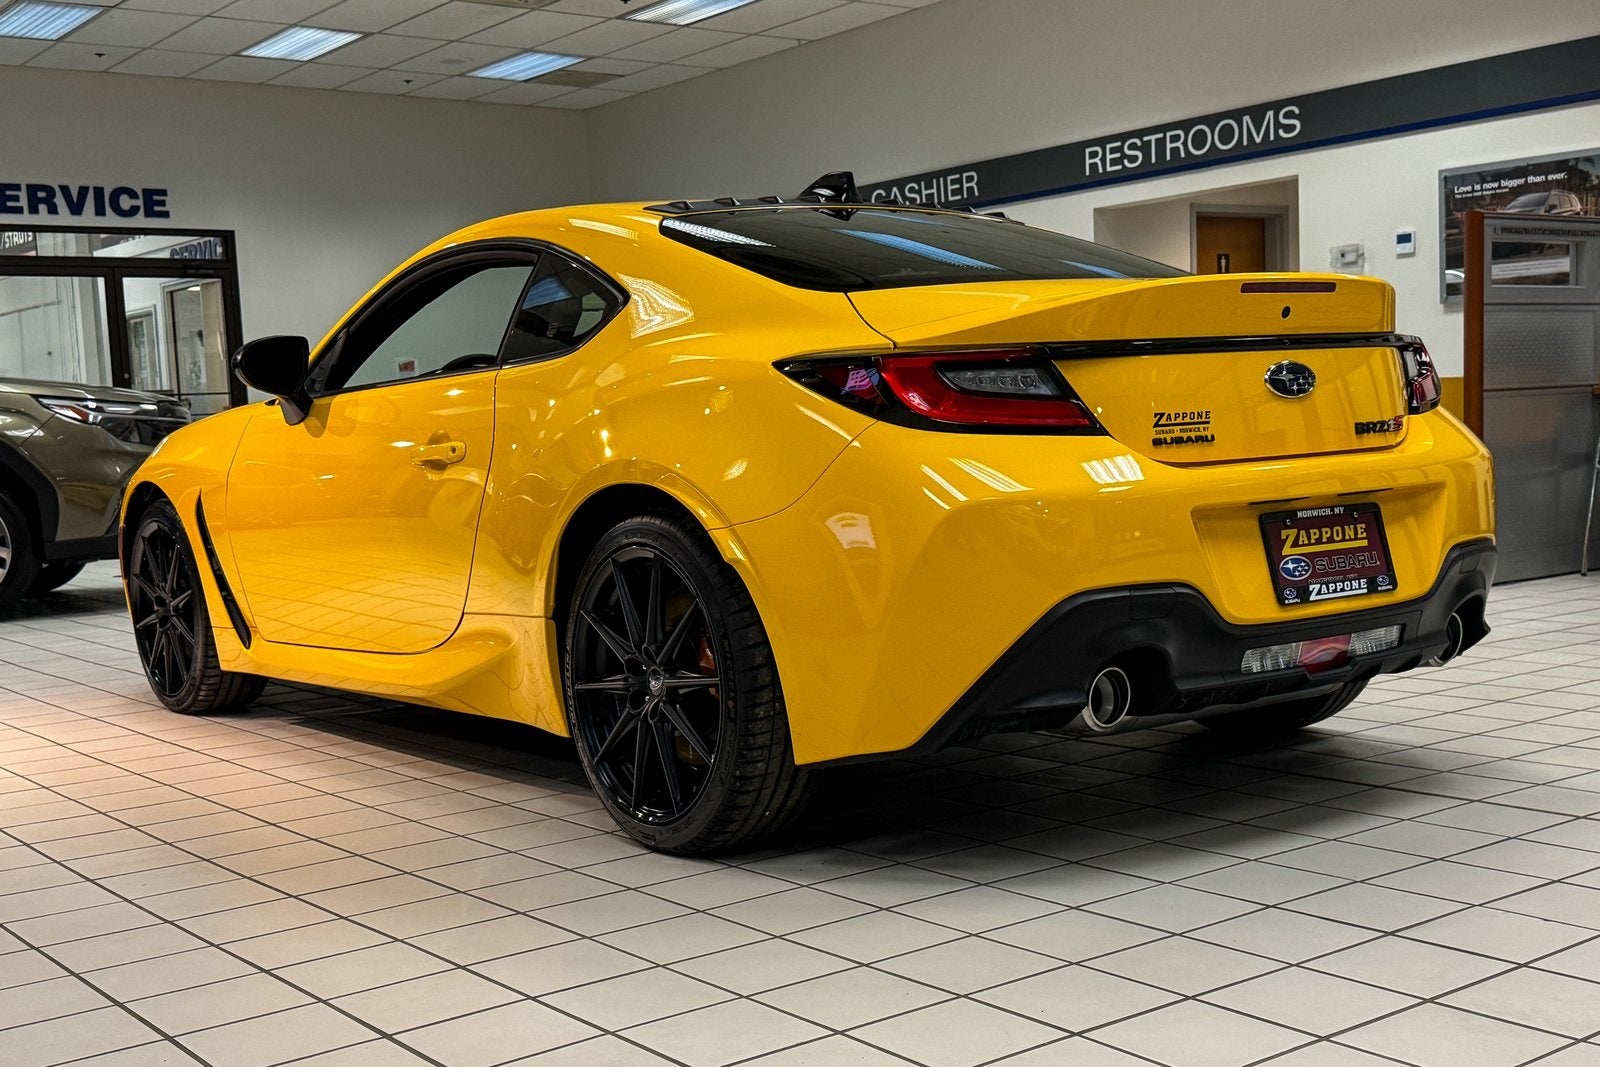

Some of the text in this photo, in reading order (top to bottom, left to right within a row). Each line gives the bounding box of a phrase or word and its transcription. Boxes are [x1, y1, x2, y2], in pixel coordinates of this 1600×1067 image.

[1085, 106, 1302, 176] RESTROOMS
[871, 171, 979, 205] CASHIER
[1454, 172, 1567, 193] Love is now bigger than ever.
[0, 183, 170, 219] ERVICE
[1153, 411, 1210, 428] ZAPPONE
[1152, 434, 1215, 446] SUBARU
[1281, 523, 1368, 555] ZAPPONE
[1315, 552, 1379, 572] SUBARU
[1309, 579, 1367, 601] ZAPPONE
